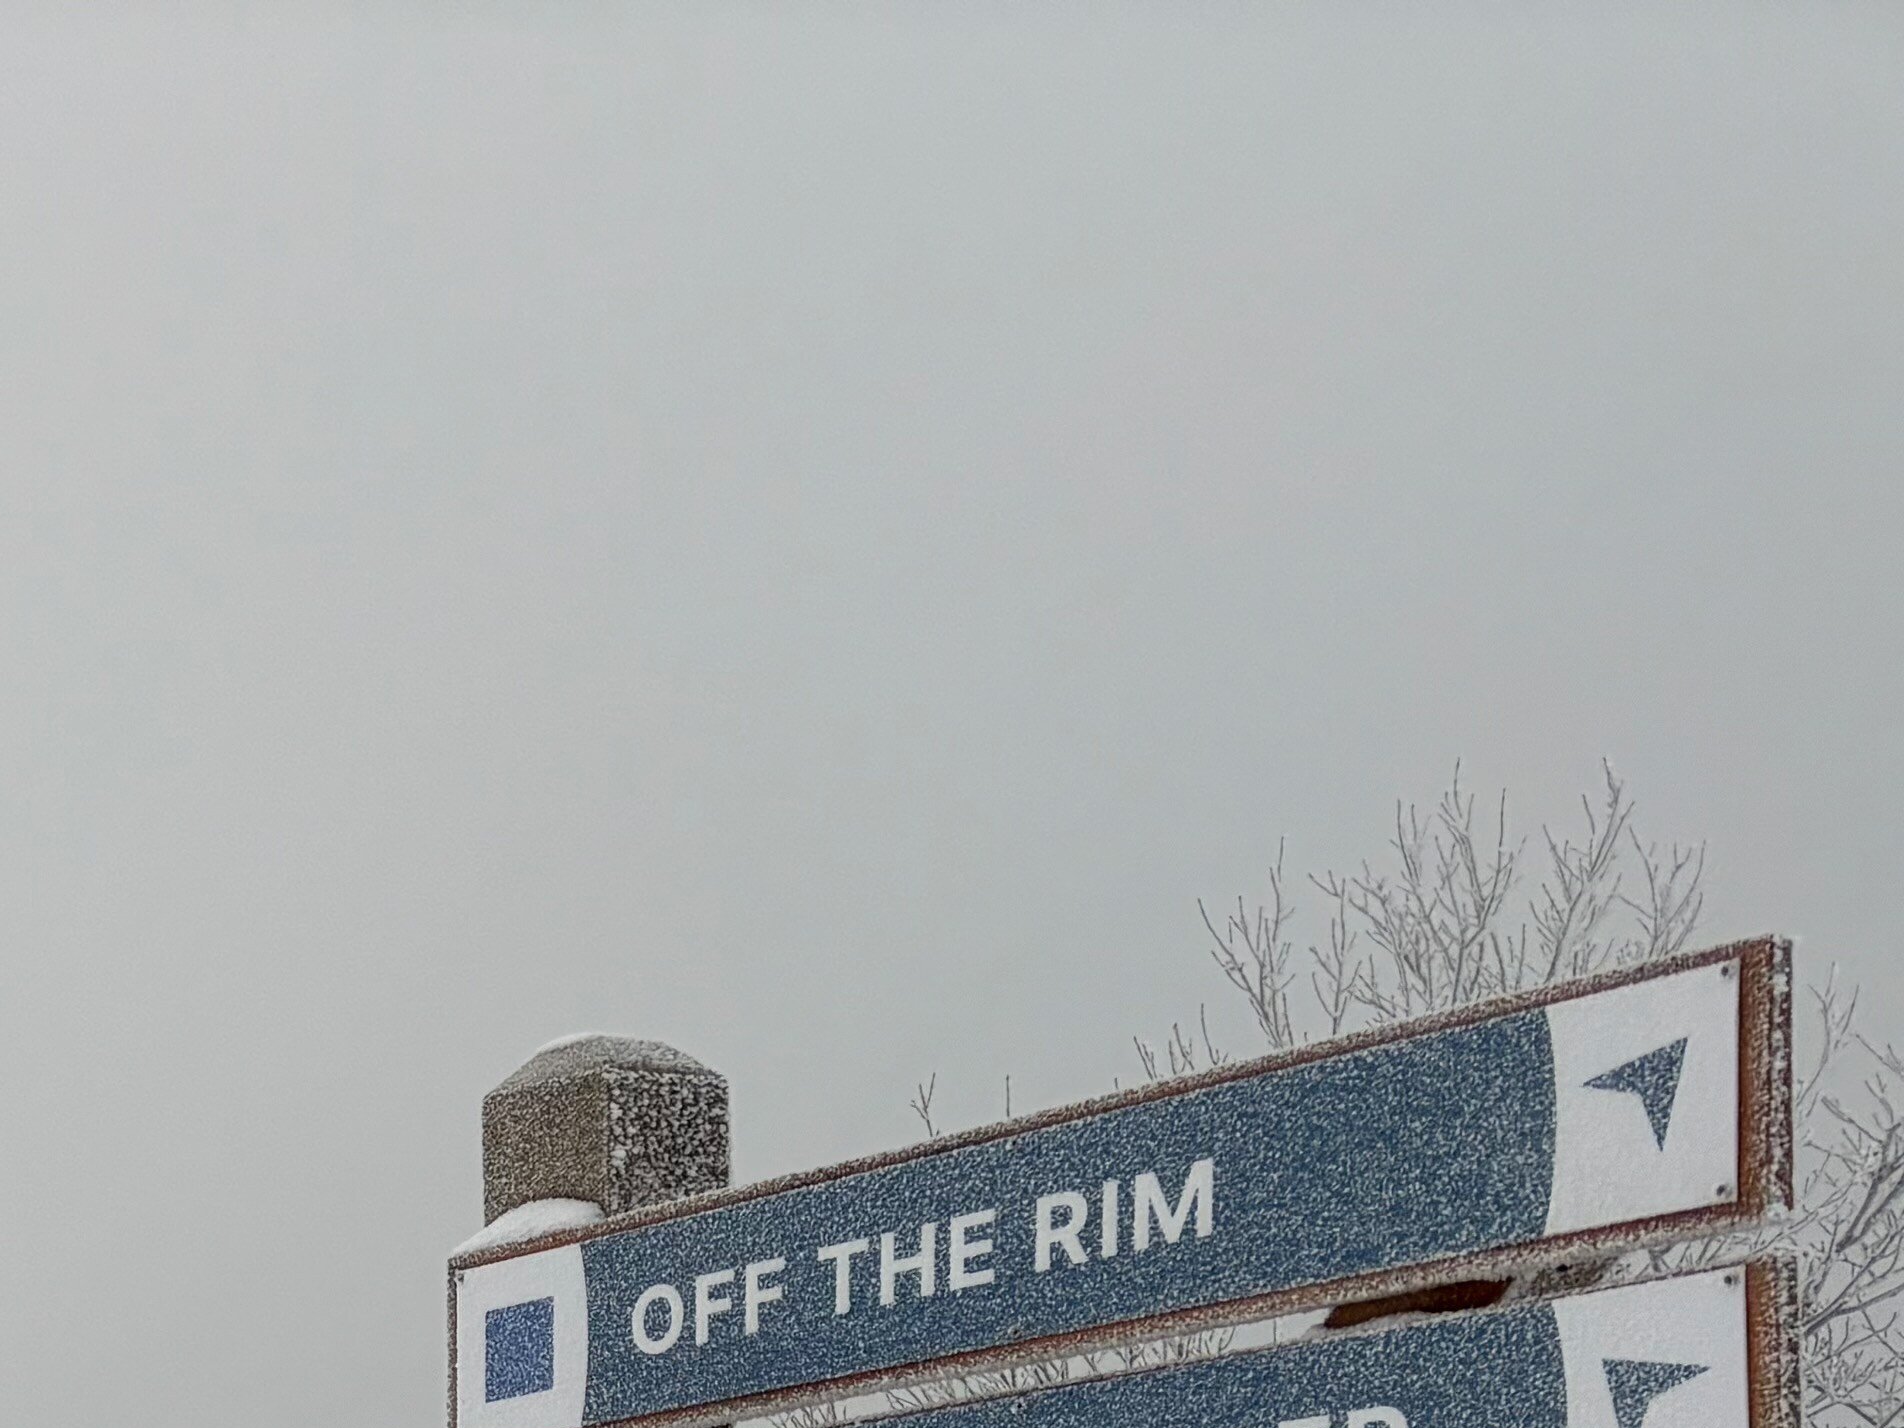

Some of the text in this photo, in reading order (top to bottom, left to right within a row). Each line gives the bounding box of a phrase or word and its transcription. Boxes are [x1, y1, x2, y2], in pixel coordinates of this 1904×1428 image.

[631, 1159, 1214, 1356] OFF THE RIM
